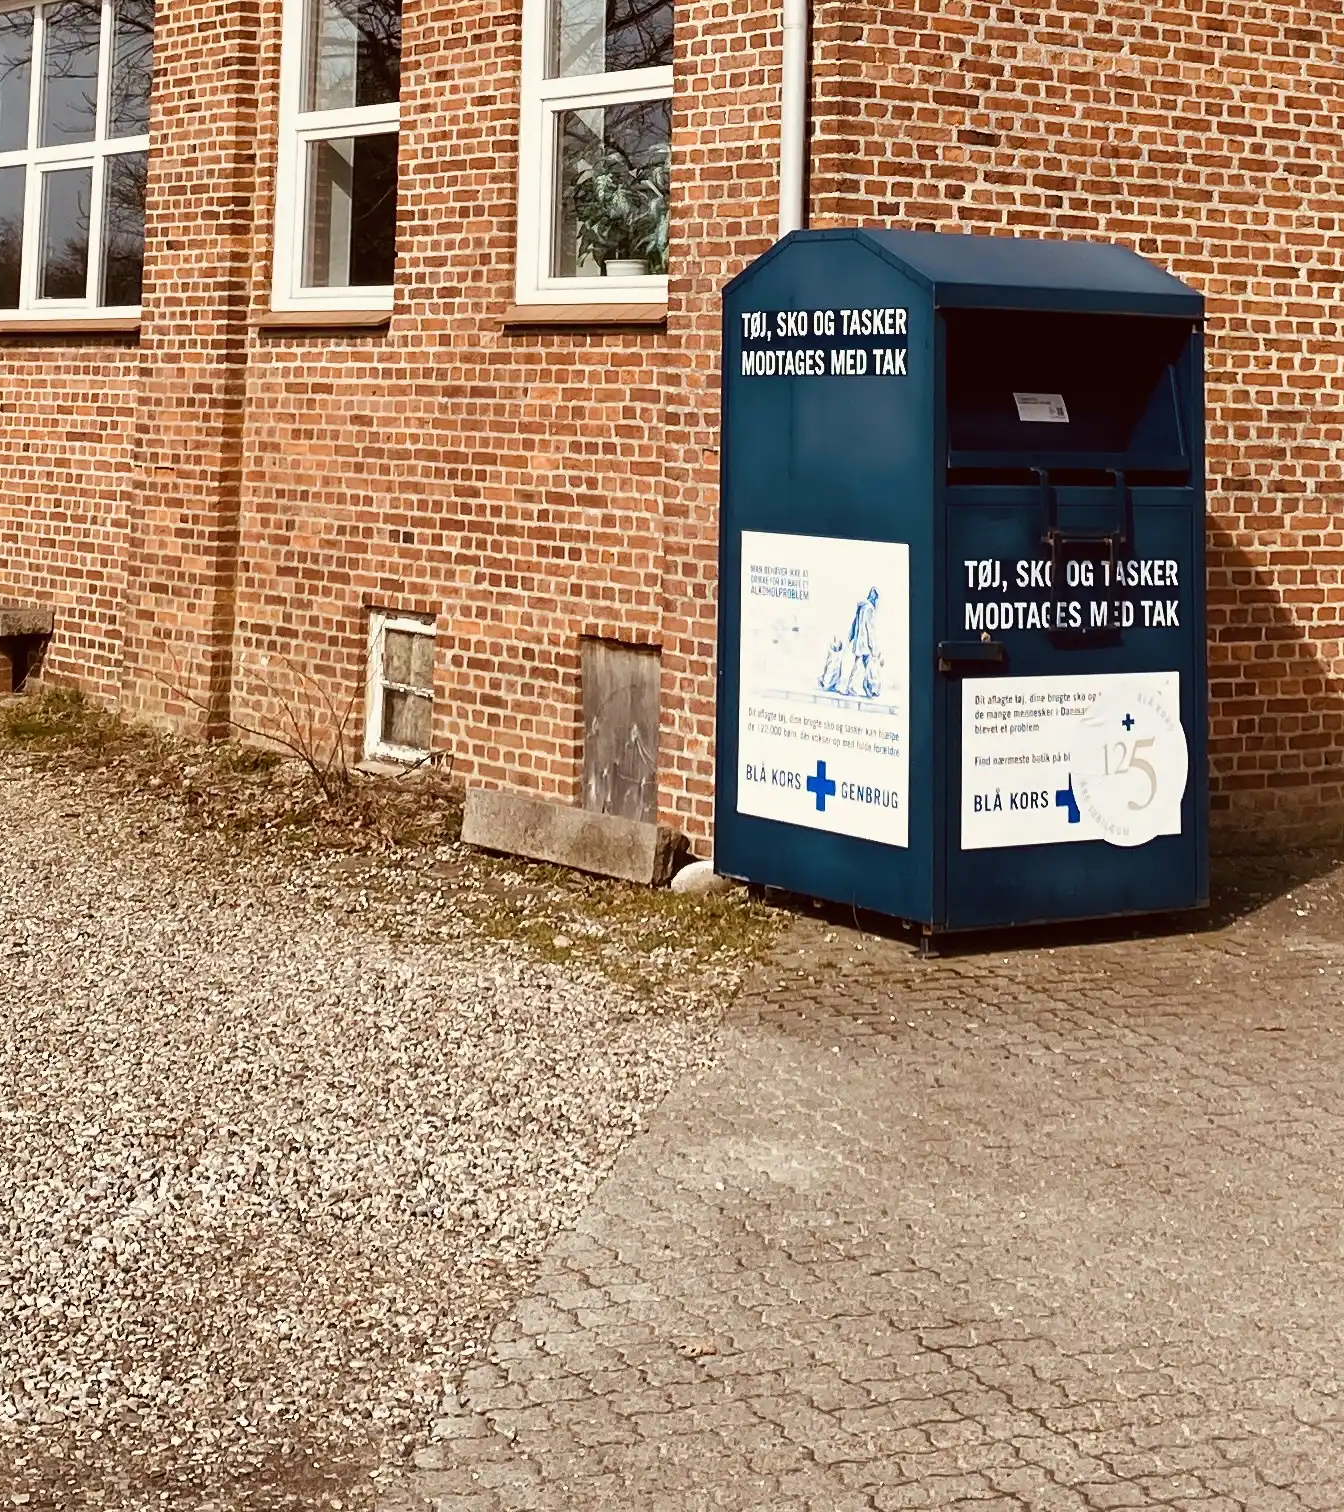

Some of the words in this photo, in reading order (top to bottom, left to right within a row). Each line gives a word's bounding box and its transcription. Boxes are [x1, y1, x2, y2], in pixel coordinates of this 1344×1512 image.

[741, 311, 772, 342] TØJ,
[776, 311, 808, 337] SKO
[813, 310, 835, 336] OG
[840, 309, 907, 336] TASKER
[741, 349, 825, 376] MODTAGES
[830, 349, 867, 376] MED
[873, 348, 907, 376] TAK
[964, 559, 1008, 592] TØJ,
[1066, 560, 1094, 587] OG
[1101, 559, 1179, 587] TASKER
[964, 601, 1082, 630] MODTAGES
[1140, 599, 1180, 627] TAK
[974, 695, 985, 705] Dit
[987, 694, 1013, 706] aflagte
[1029, 693, 1046, 703] dine
[1047, 693, 1071, 705] brugte
[1073, 692, 1086, 702] sko
[1088, 693, 1097, 702] og
[974, 710, 984, 720] de
[986, 709, 1011, 721] mange
[1013, 708, 1053, 718] mennesker
[974, 725, 999, 734] blevet
[1000, 724, 1008, 734] et
[1009, 723, 1040, 735] problem
[974, 756, 991, 766] Find
[746, 762, 767, 784] BLÅ
[771, 768, 802, 790] KORS
[841, 781, 899, 809] GENBRUG
[974, 787, 1003, 813] BLÅ
[1009, 790, 1049, 811] KORS
